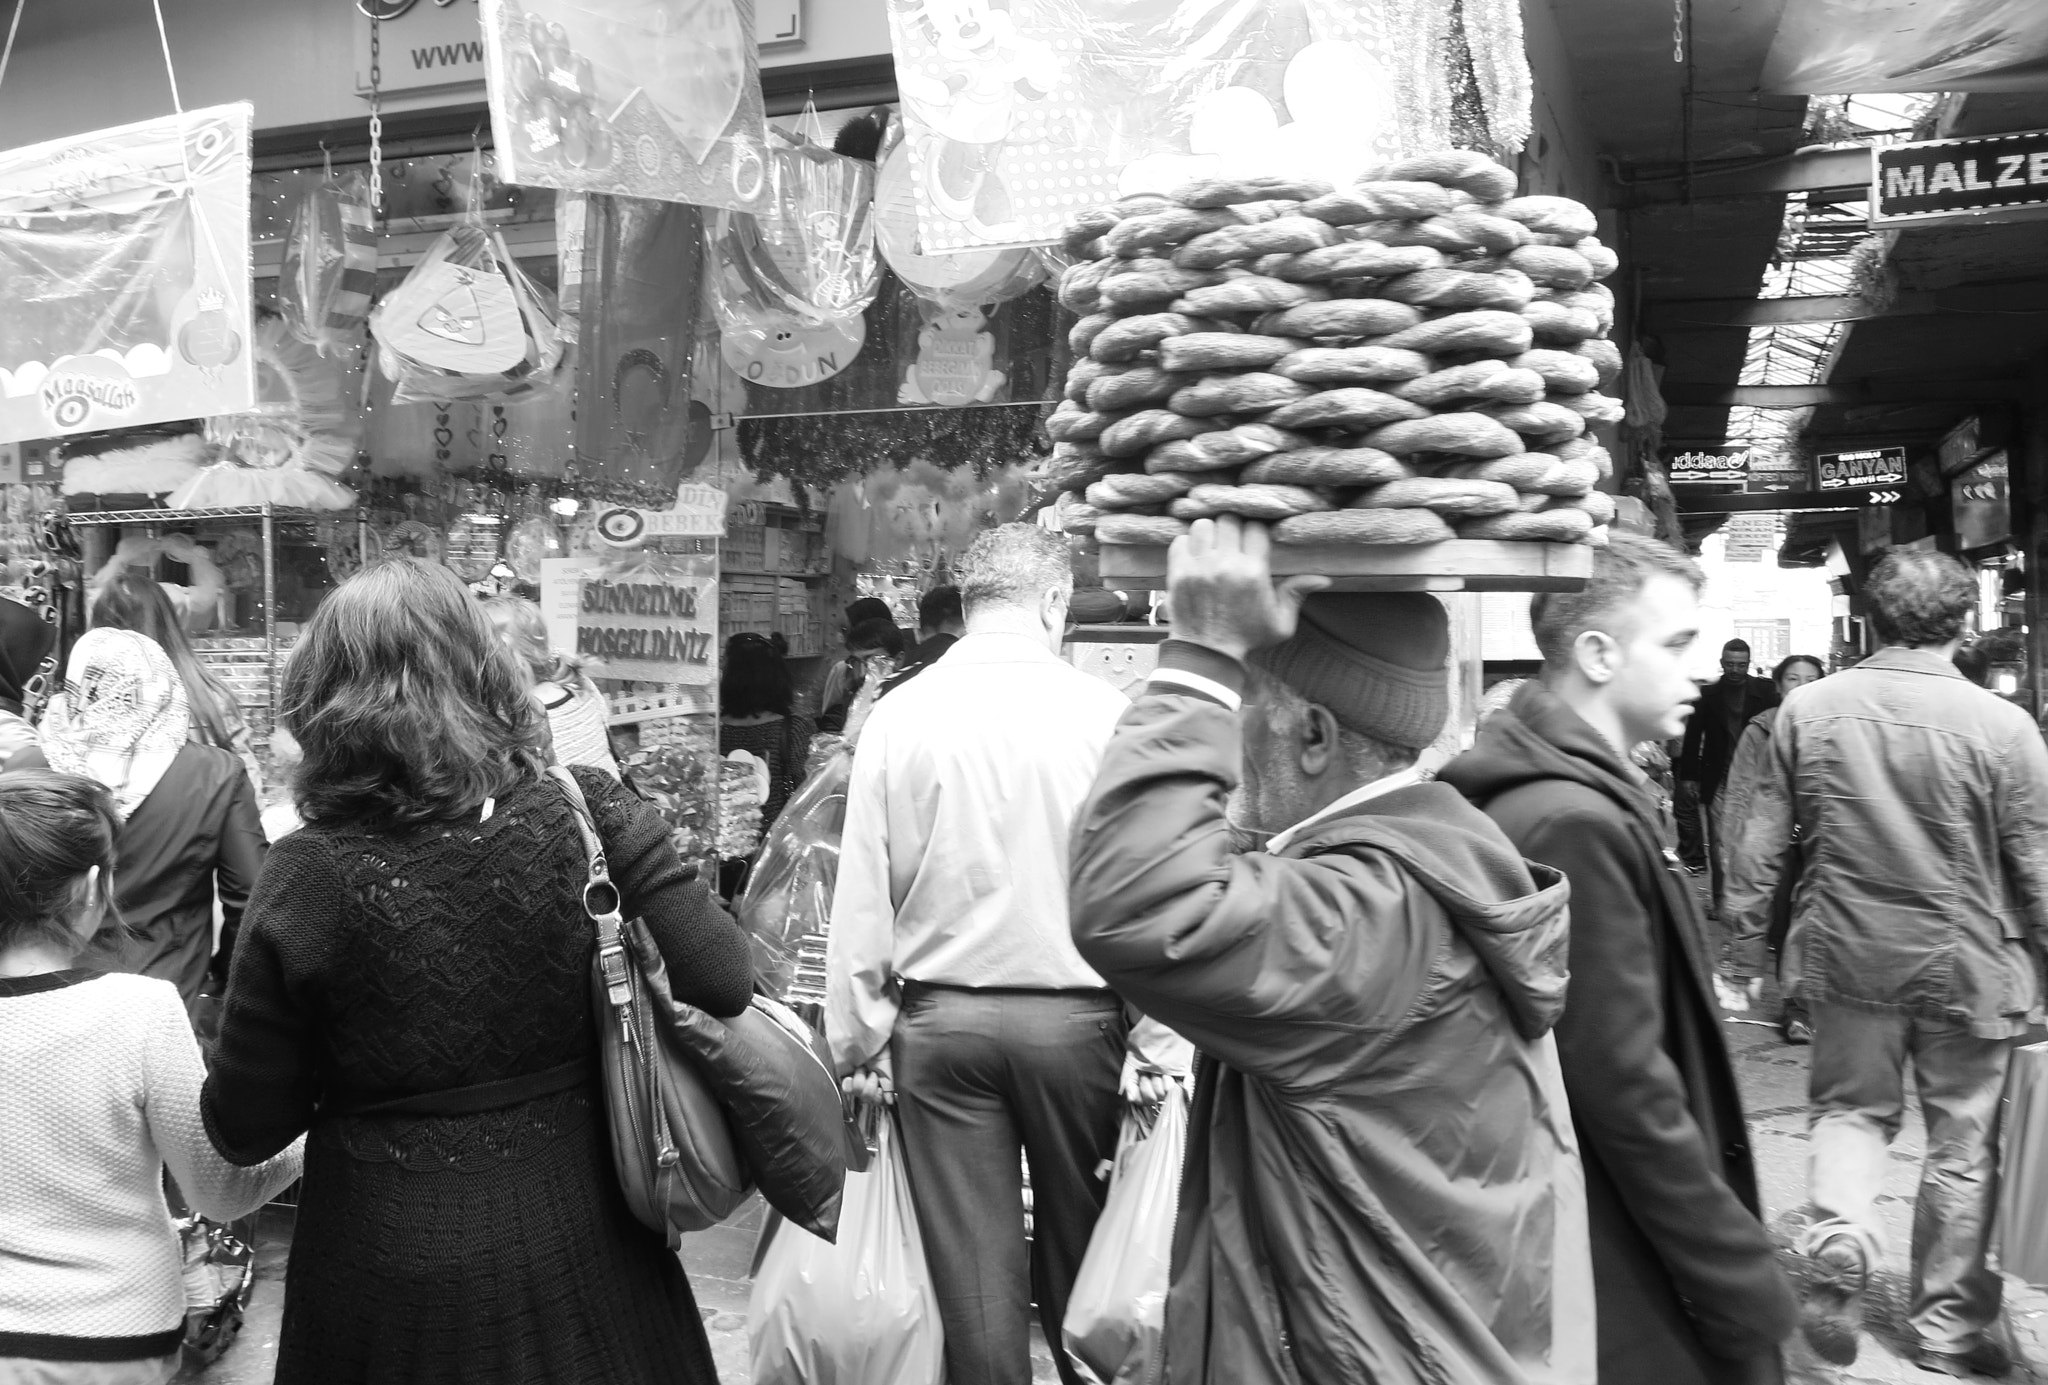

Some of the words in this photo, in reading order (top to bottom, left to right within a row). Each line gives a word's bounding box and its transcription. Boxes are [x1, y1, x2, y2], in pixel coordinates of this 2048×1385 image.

[1886, 152, 2048, 198] MALZE
[1821, 457, 1903, 479] GANYAN
[647, 513, 721, 534] BEBEK
[1731, 519, 1772, 527] ENES
